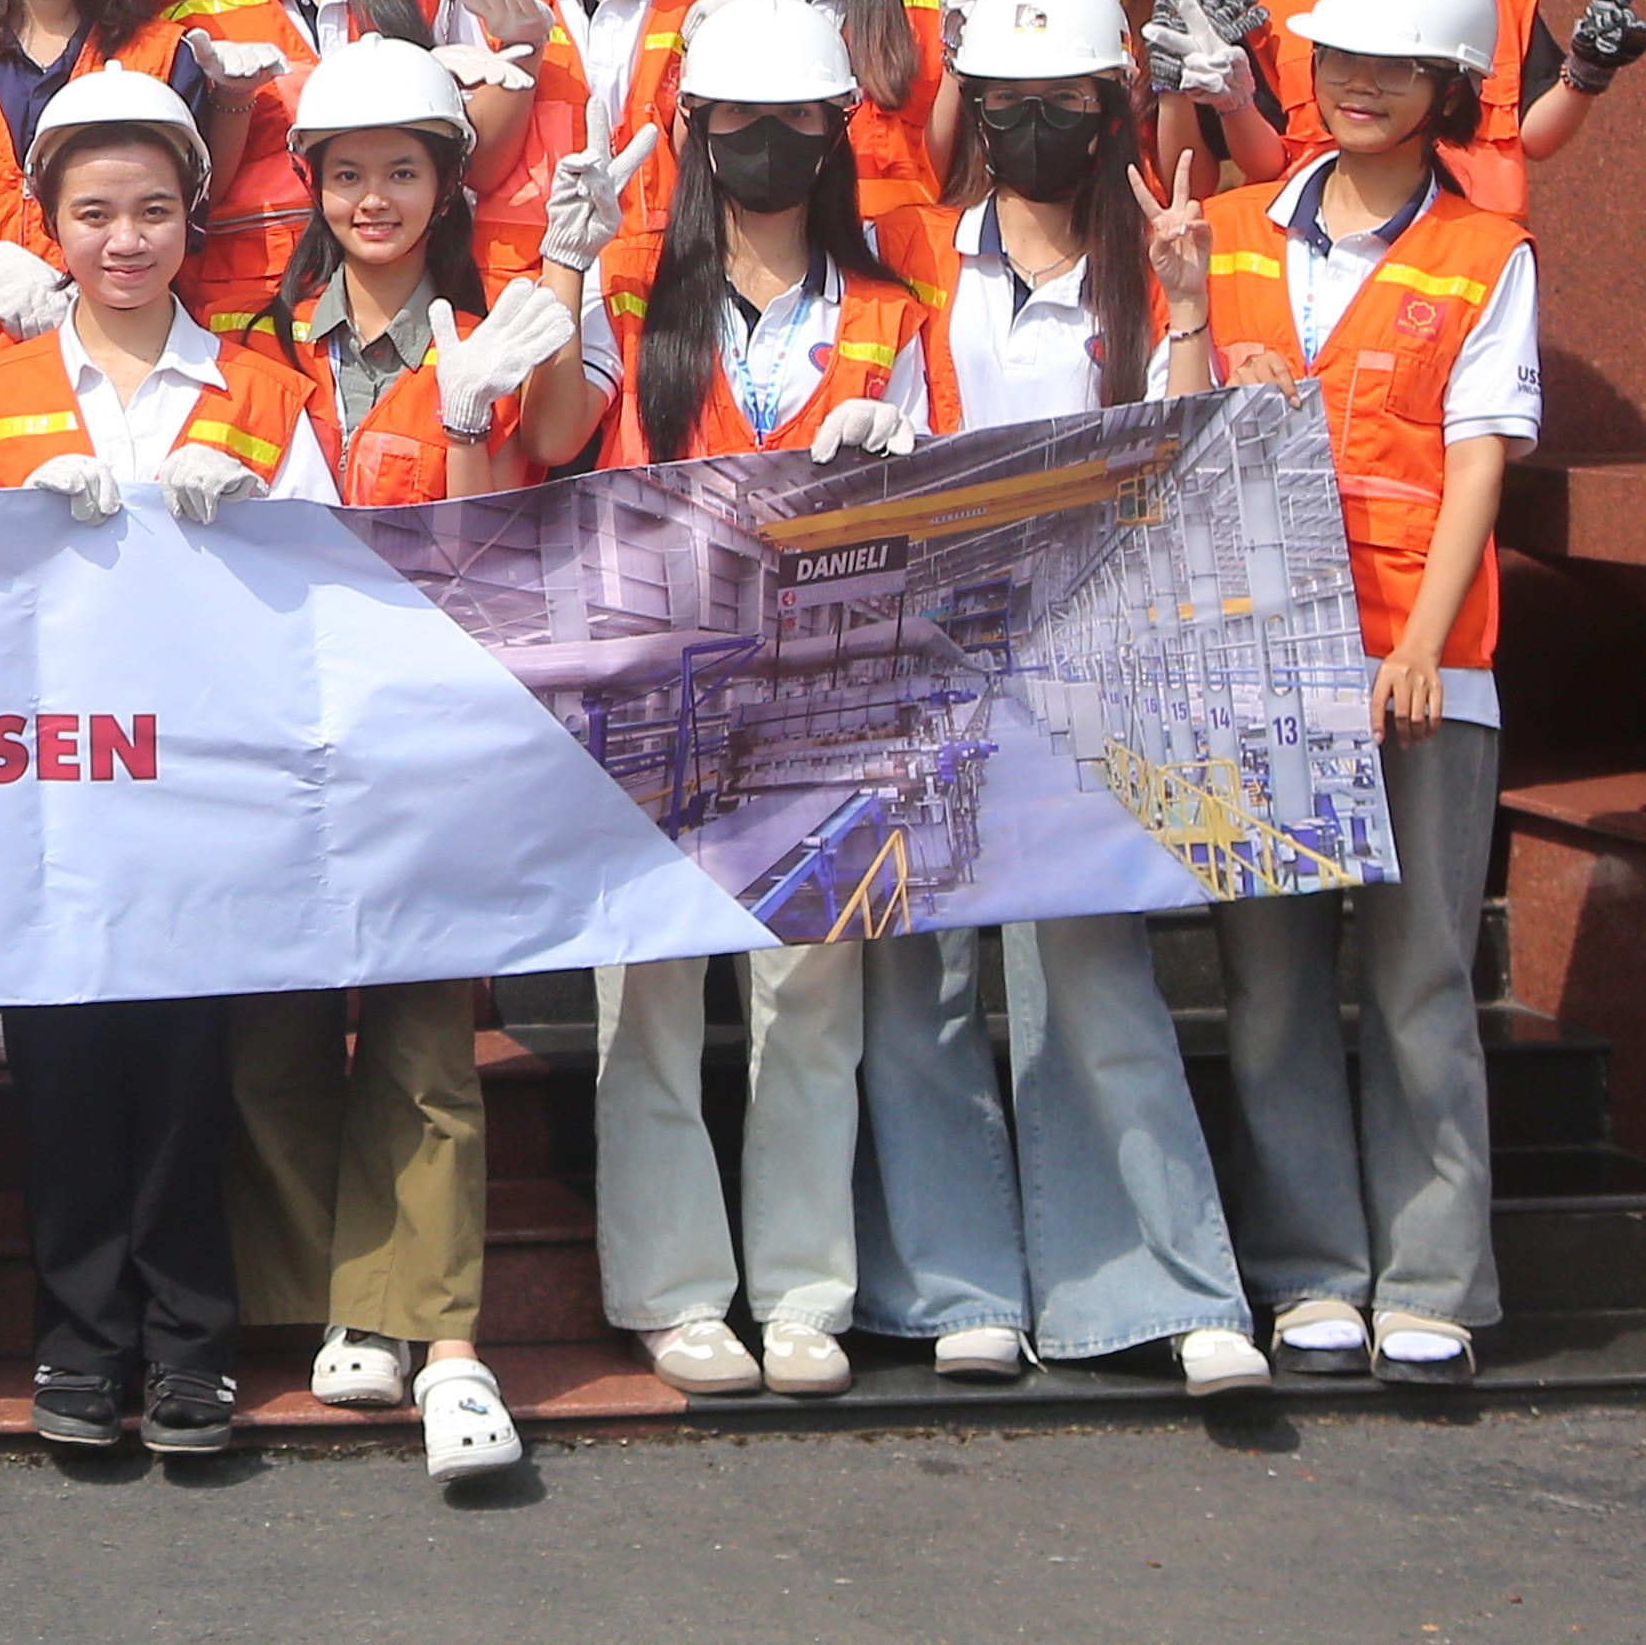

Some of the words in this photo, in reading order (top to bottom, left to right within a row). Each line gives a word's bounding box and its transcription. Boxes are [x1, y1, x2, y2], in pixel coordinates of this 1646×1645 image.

[795, 544, 890, 583] DANIELI
[1171, 701, 1188, 722] 15
[1210, 706, 1231, 731] 14
[1272, 715, 1299, 747] 13
